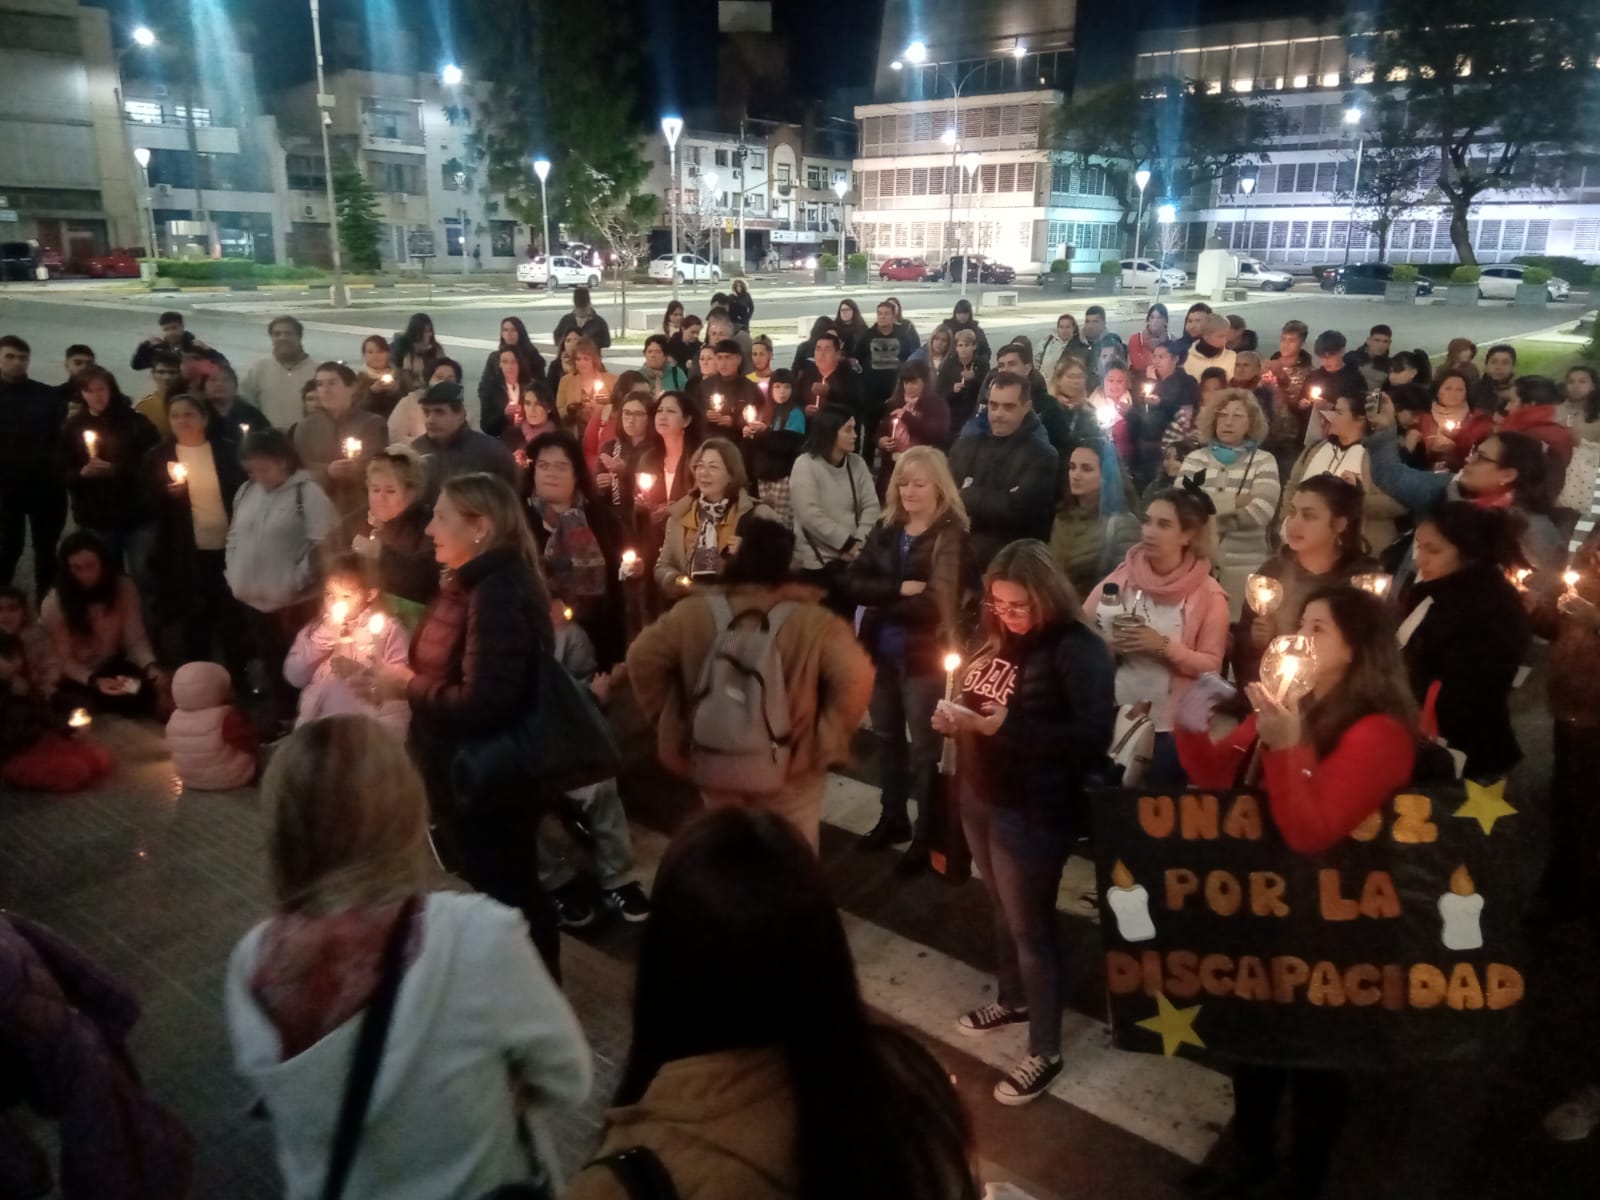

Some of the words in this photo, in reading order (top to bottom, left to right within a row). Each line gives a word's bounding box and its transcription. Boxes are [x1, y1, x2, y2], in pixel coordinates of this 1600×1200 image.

[1137, 795, 1262, 840] UNA
[1165, 868, 1290, 917] POR
[1319, 868, 1402, 921] LA
[1107, 951, 1525, 1010] DISCAPACIDAD
